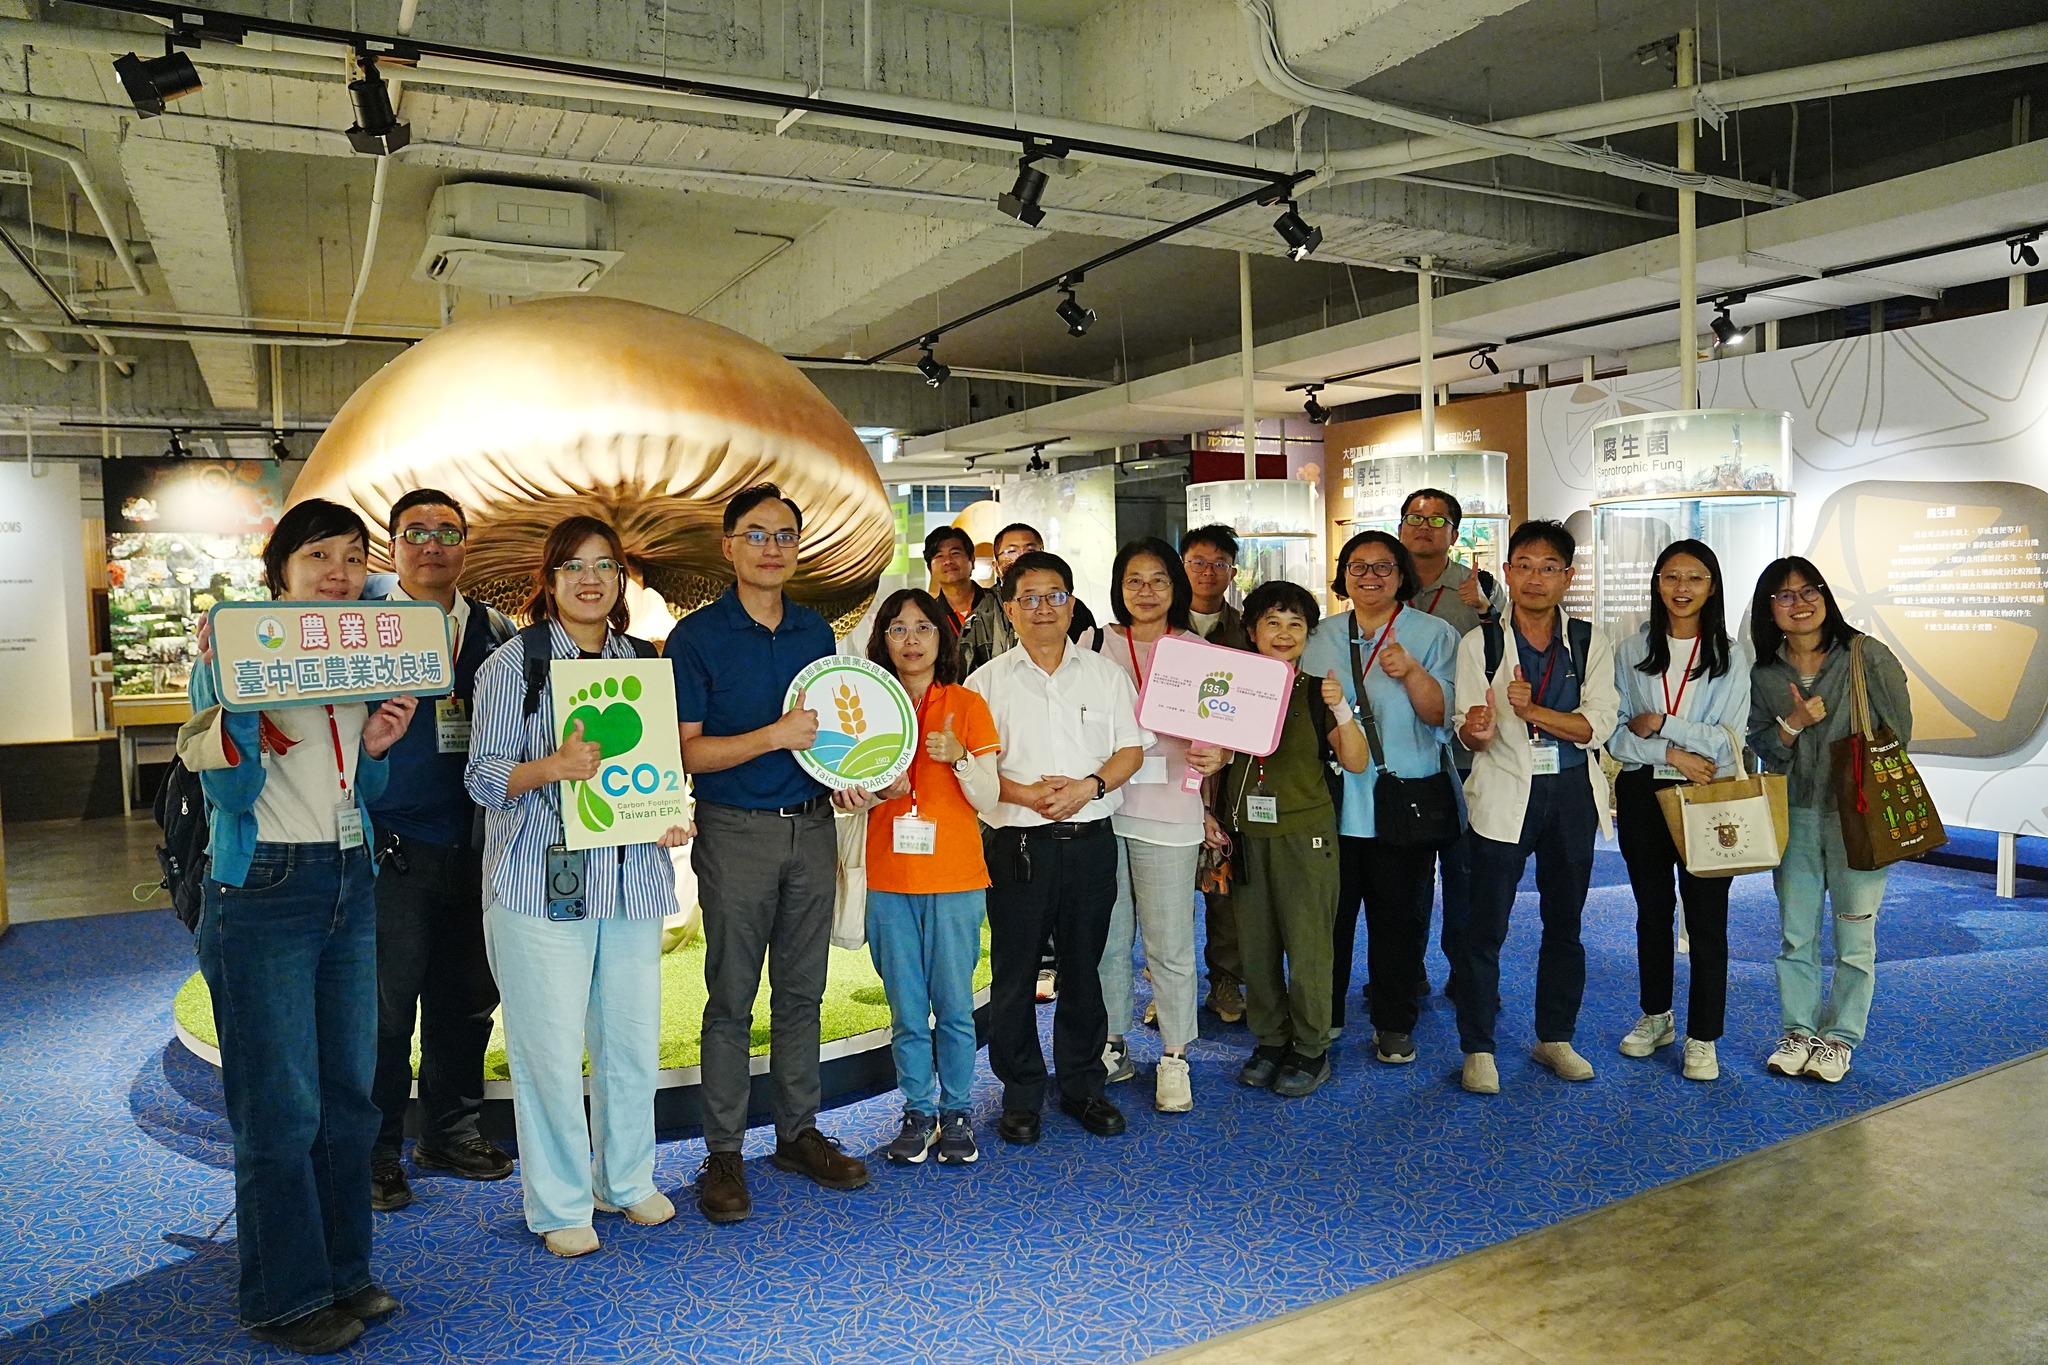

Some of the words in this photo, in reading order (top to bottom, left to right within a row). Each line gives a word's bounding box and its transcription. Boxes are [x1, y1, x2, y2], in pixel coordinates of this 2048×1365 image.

[1603, 430, 1669, 462] 腐生菌
[1598, 461, 1648, 479] Saprotrophic
[1652, 457, 1686, 474] Fungi
[1381, 486, 1405, 498] Fungi
[300, 613, 403, 650] 農業部
[233, 650, 443, 698] 臺中區農業改良場
[1203, 683, 1225, 696] 135g
[1208, 698, 1237, 714] CO2
[894, 751, 911, 772] MOA
[601, 762, 680, 798] CO2
[617, 801, 645, 810] Carbon
[648, 798, 681, 808] Footprint
[618, 810, 657, 820] Taiwan
[660, 806, 682, 817] EPA
